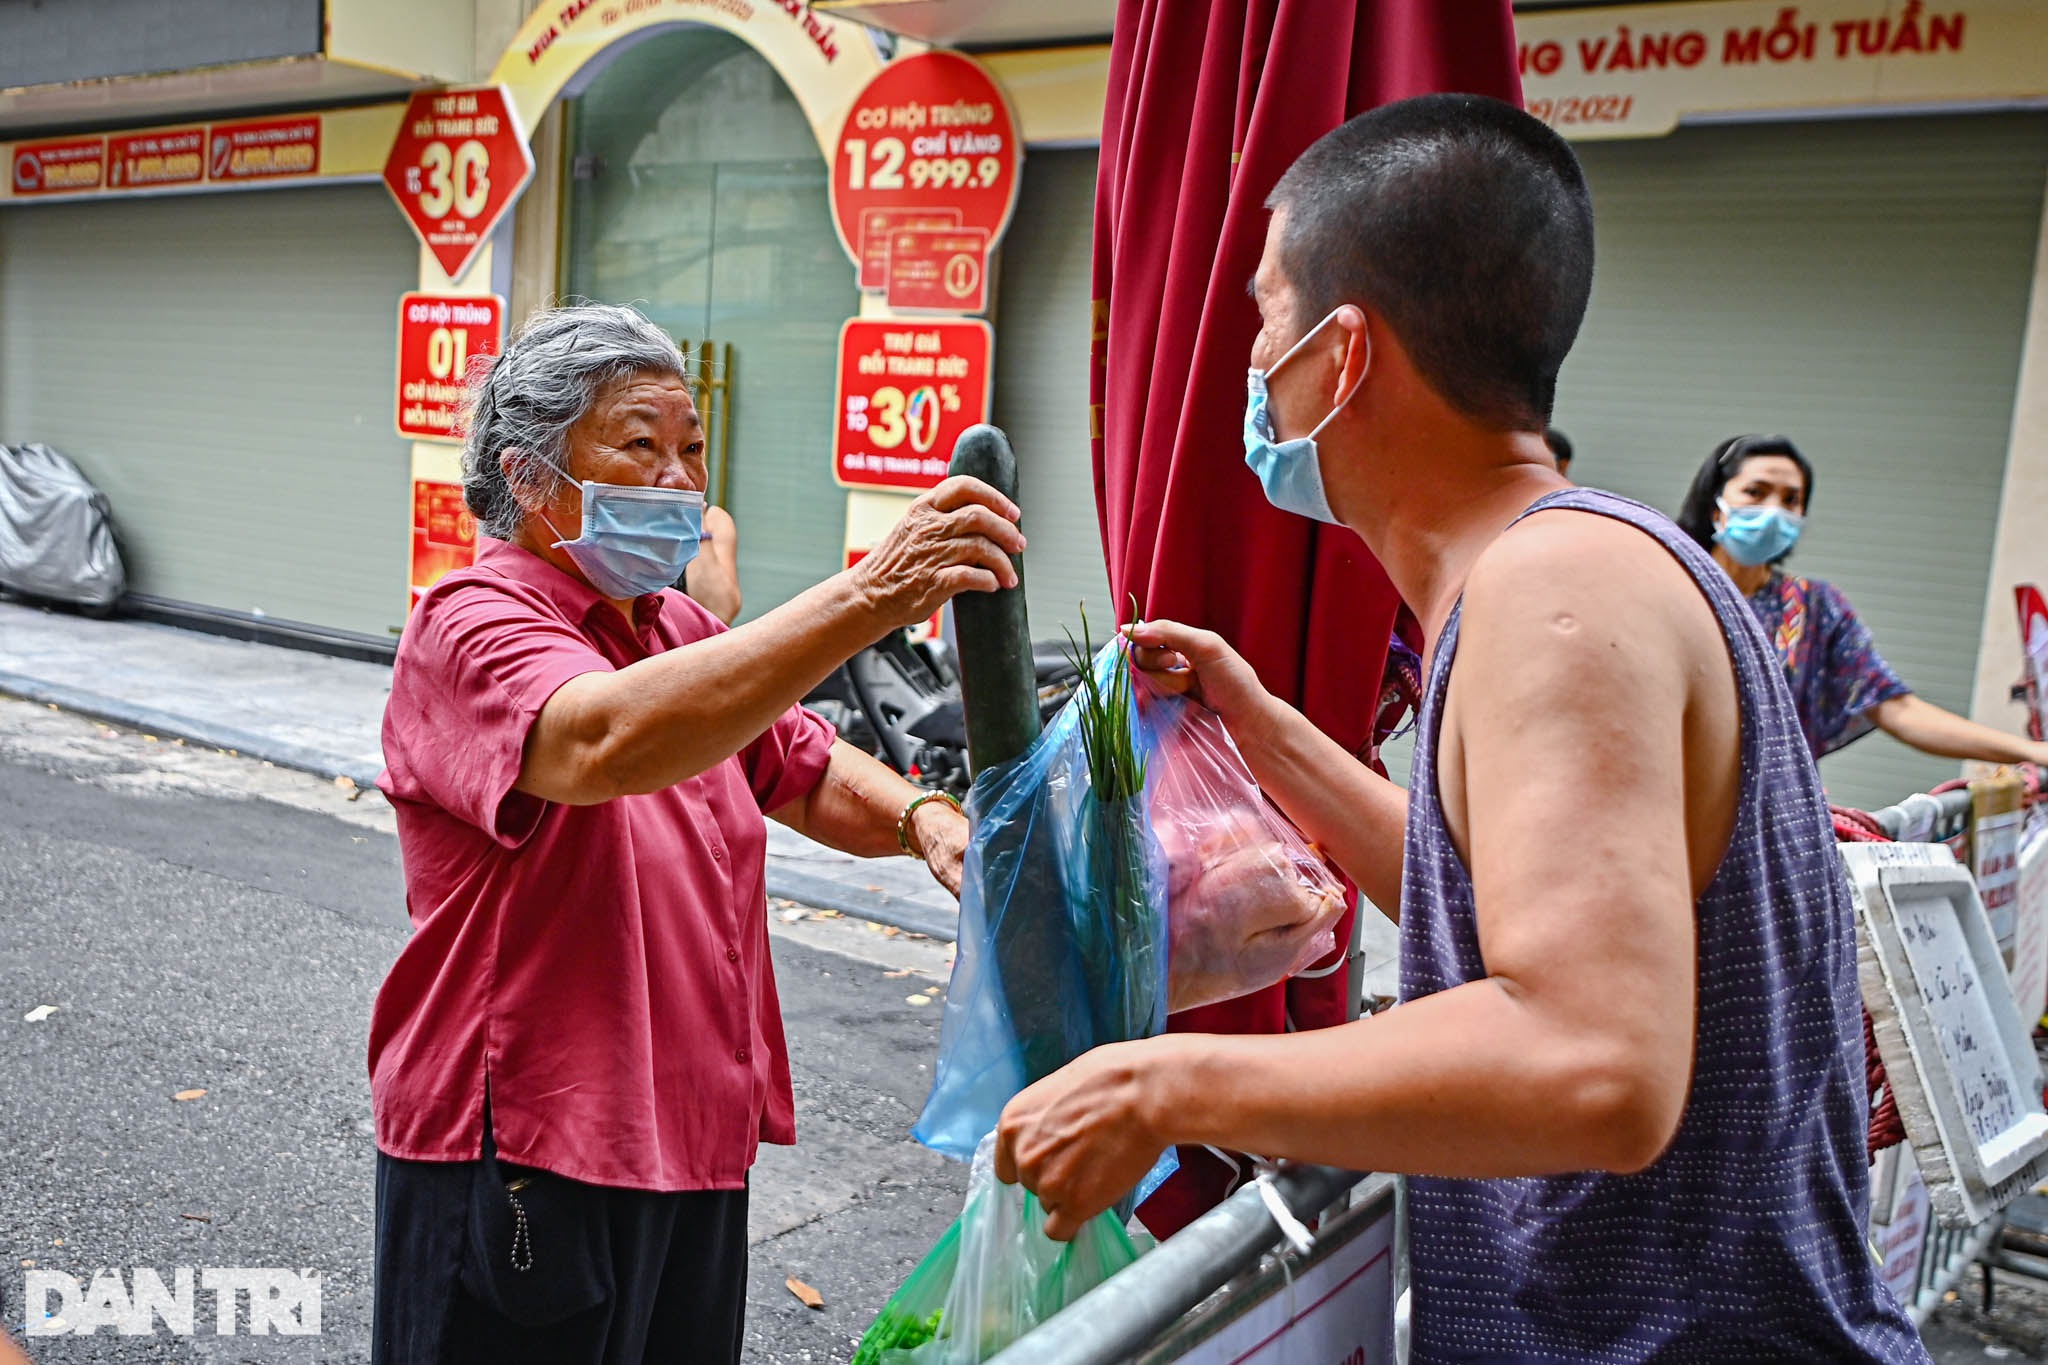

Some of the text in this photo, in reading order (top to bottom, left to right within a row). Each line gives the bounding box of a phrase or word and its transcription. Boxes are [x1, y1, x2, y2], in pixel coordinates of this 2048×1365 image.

[1577, 25, 1708, 74] VÀNG
[1722, 7, 1818, 65] MỖI
[1831, 0, 1967, 60] TUẦN
[891, 102, 927, 133] HỘI
[846, 137, 907, 190] 12
[909, 157, 1001, 190] 999.9
[428, 328, 468, 381] 01
[888, 357, 935, 377] TRANG
